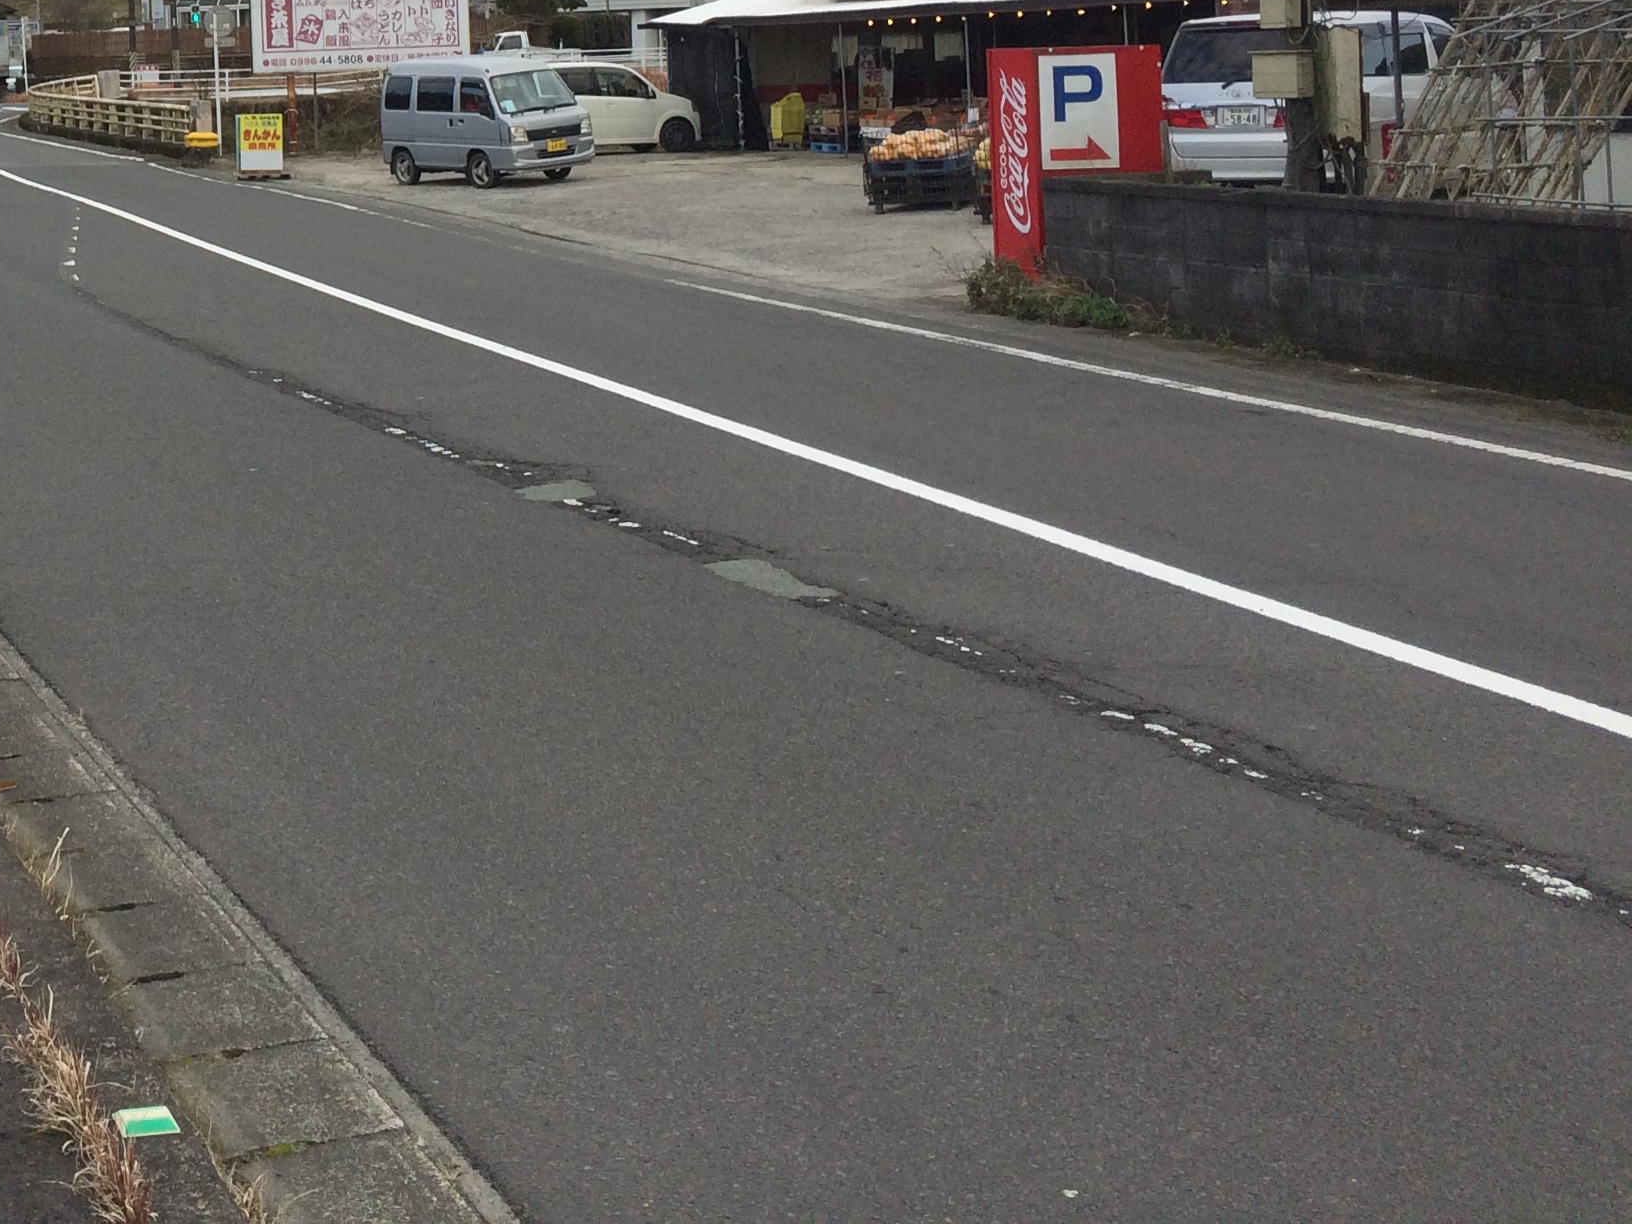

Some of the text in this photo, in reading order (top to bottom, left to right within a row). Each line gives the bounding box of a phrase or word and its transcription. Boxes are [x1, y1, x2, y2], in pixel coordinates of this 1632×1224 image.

[378, 9, 391, 45] うどん
[391, 9, 402, 45] カレー
[1053, 65, 1103, 122] P
[999, 67, 1031, 234] Coca-Cola
